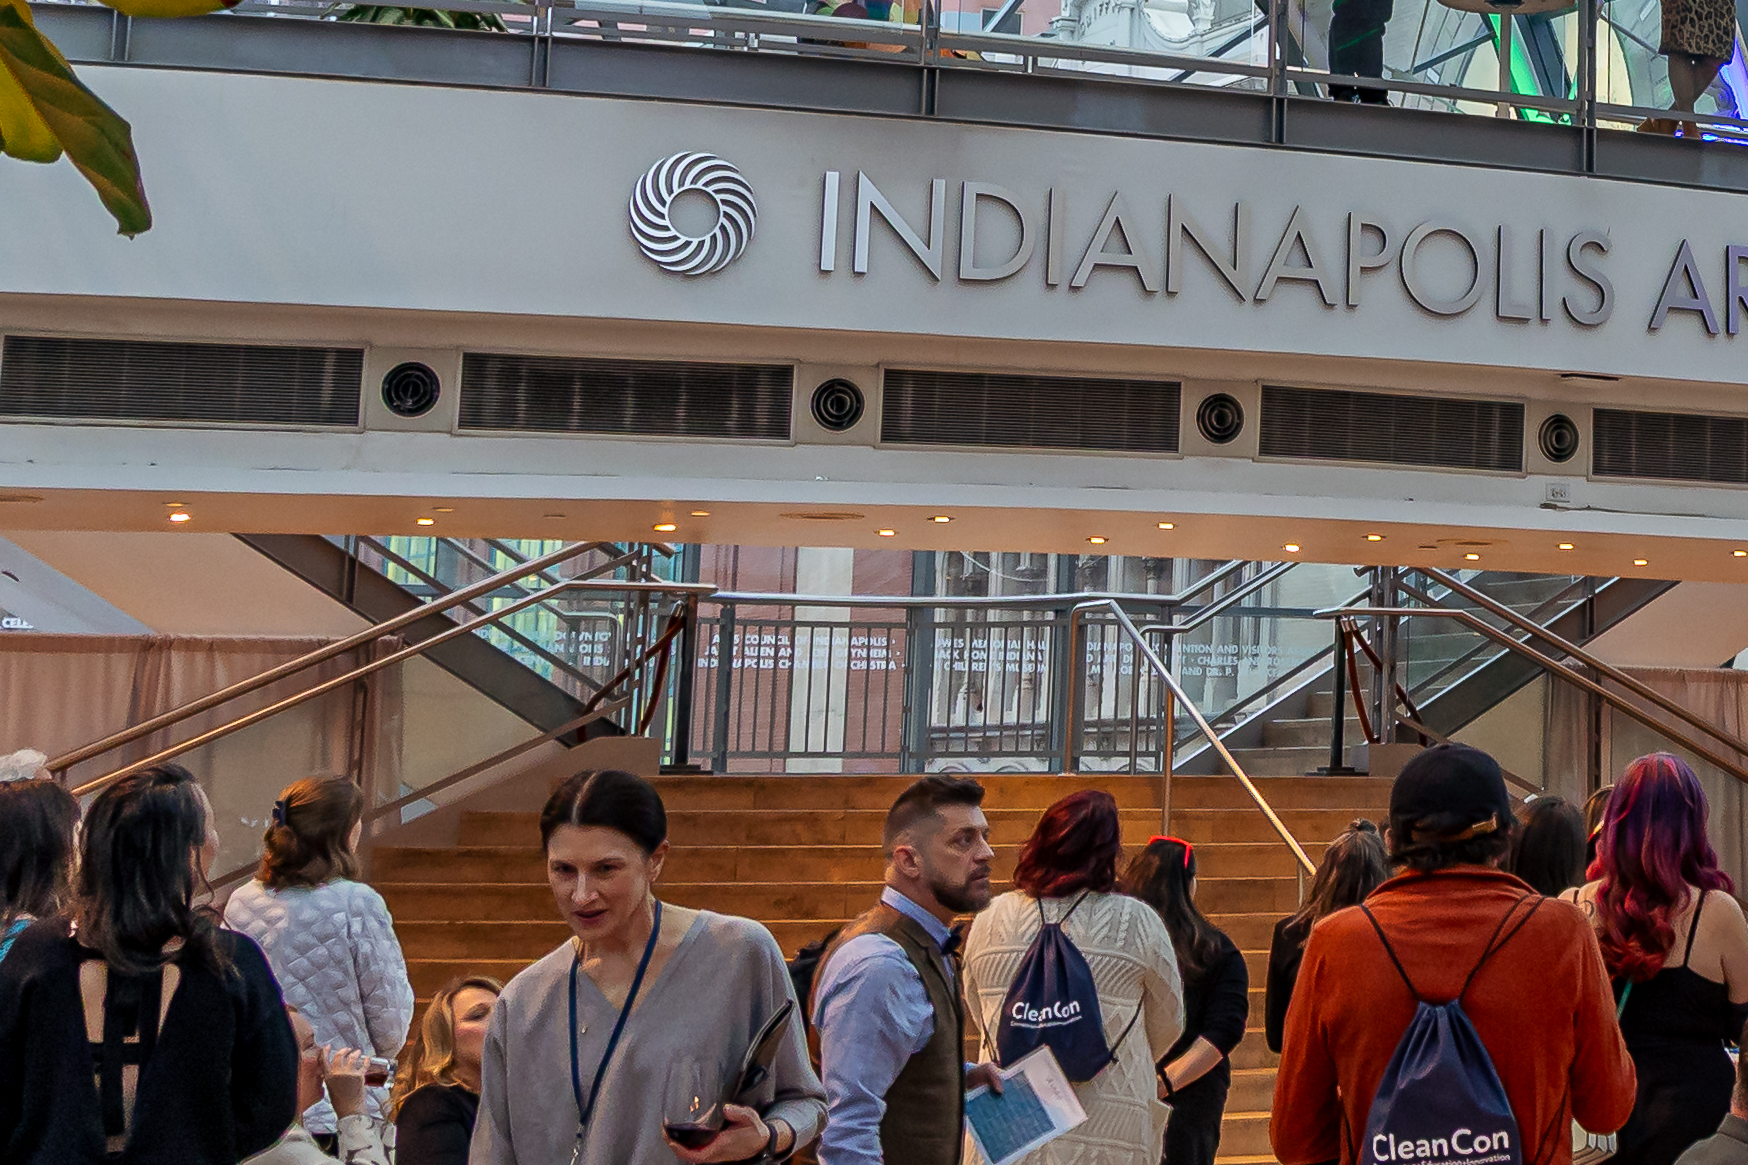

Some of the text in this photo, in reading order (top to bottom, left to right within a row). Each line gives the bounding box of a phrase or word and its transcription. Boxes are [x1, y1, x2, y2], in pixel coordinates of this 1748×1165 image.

[819, 169, 1616, 327] INDIANAPOLIS
[1216, 645, 1239, 654] AND
[833, 660, 896, 670] ORCHSTRA
[1197, 656, 1239, 666] CHARLES
[1012, 1001, 1080, 1022] ClenCon
